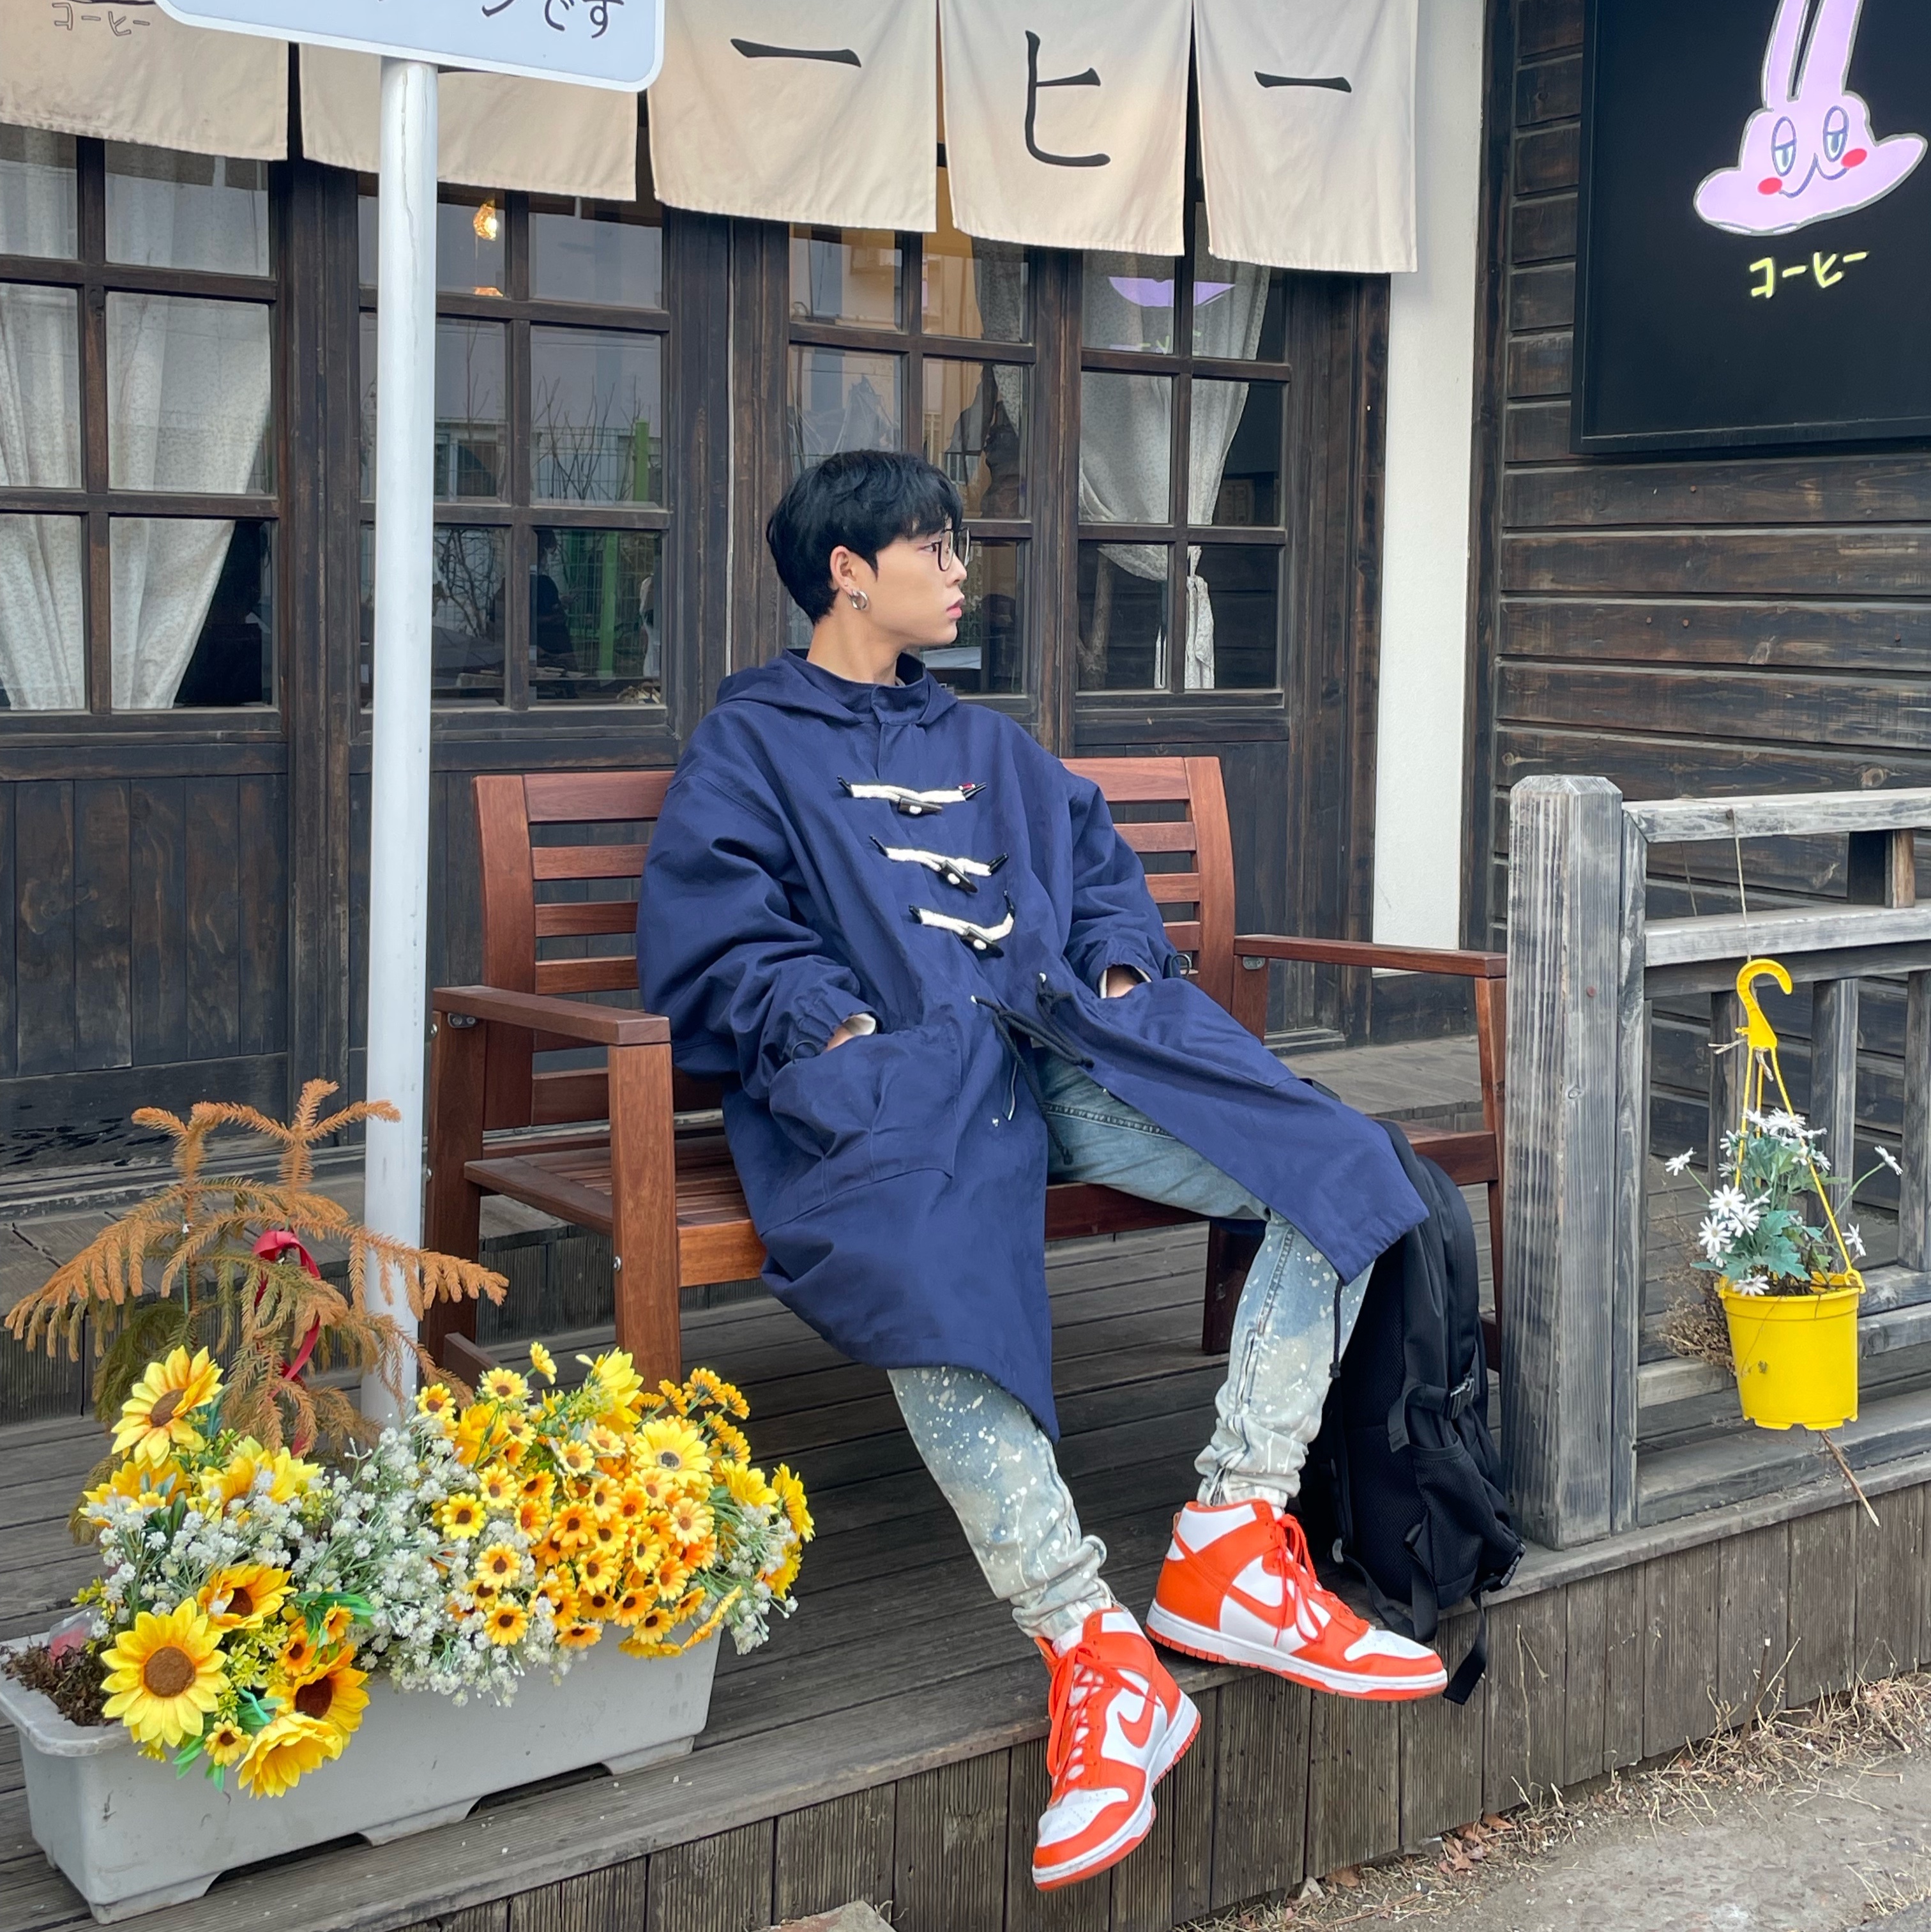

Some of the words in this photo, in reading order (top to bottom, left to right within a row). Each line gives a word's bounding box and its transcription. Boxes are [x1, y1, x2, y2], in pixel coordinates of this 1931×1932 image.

[52, 2, 151, 36] コーヒー
[1749, 251, 1868, 298] コーヒー
